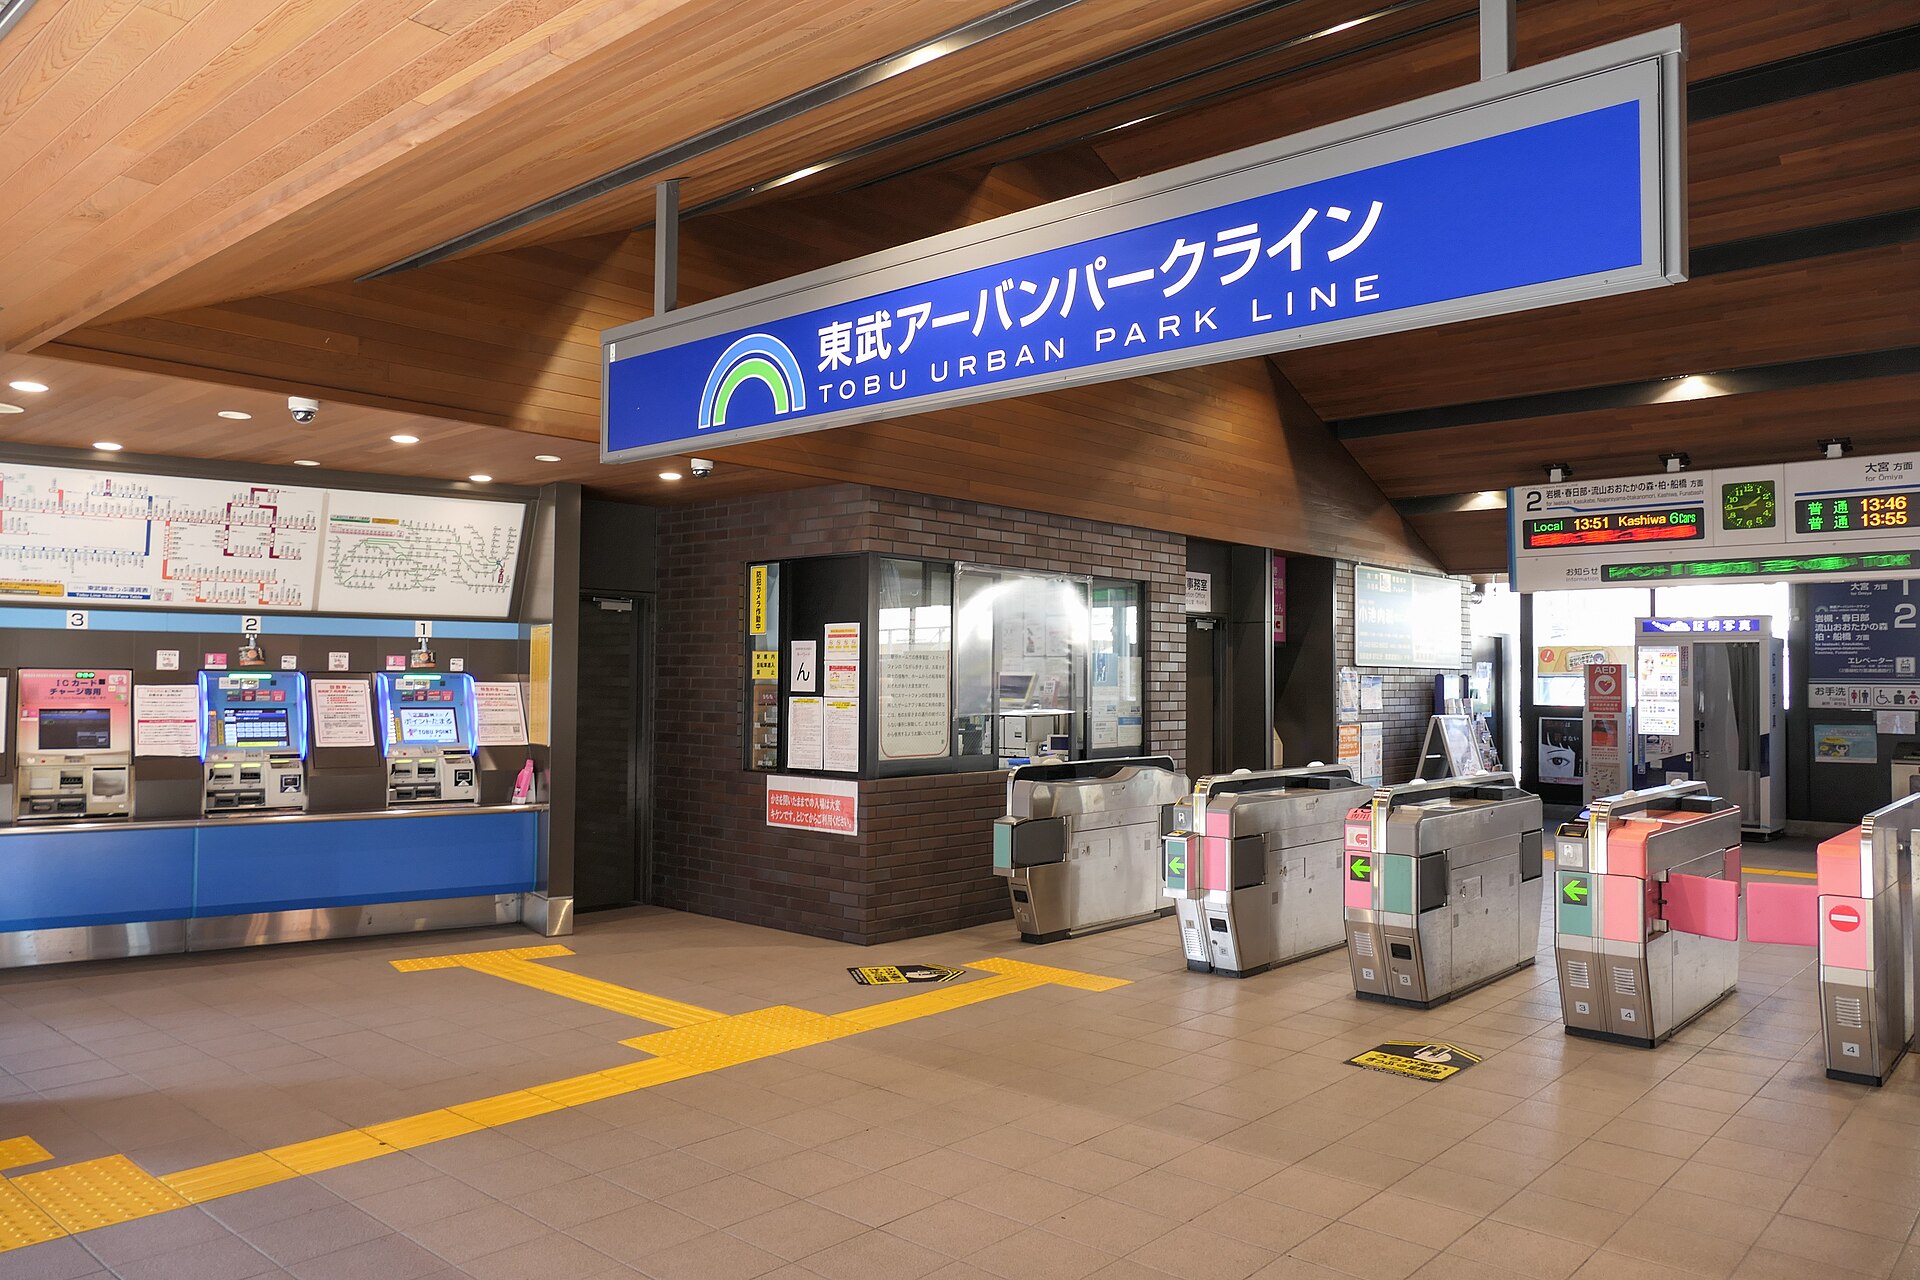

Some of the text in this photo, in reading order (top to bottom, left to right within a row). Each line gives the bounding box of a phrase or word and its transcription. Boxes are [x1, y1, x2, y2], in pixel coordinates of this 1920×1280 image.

[817, 199, 1384, 374] 東武アーバンパークライン
[818, 273, 1381, 405] TOBU URBAN PARK LINE
[1865, 461, 1913, 473] 大宮 方面
[1690, 479, 1704, 488] 方面
[1744, 484, 1753, 492] 12
[1526, 490, 1542, 512] 2
[1808, 495, 1907, 516] 普通 13:46
[1534, 520, 1564, 532] Local
[1574, 517, 1609, 531] 13:51
[1618, 514, 1667, 527] Kashiwa
[1808, 511, 1908, 530] 普通 13:55
[1566, 568, 1599, 576] お知らせ
[1850, 582, 1870, 590] 大宮
[1902, 580, 1909, 596] 1
[71, 613, 84, 627] 3
[1814, 614, 1870, 622] 岩槻・春日部
[1894, 603, 1917, 628] 2
[246, 618, 258, 631] 2
[420, 624, 426, 634] 1
[1692, 620, 1752, 632] 証明写真
[1814, 622, 1888, 631] 流山おおたかの森
[1814, 632, 1852, 641] 柏・船橋
[797, 662, 810, 681] ん
[1594, 666, 1616, 674] AED
[50, 688, 101, 696] チャージ専用
[1814, 687, 1846, 696] お手洗
[770, 793, 841, 812] かさを開いたままでの入場は大変
[770, 808, 852, 829] キケンです。とじてからご利用ください。
